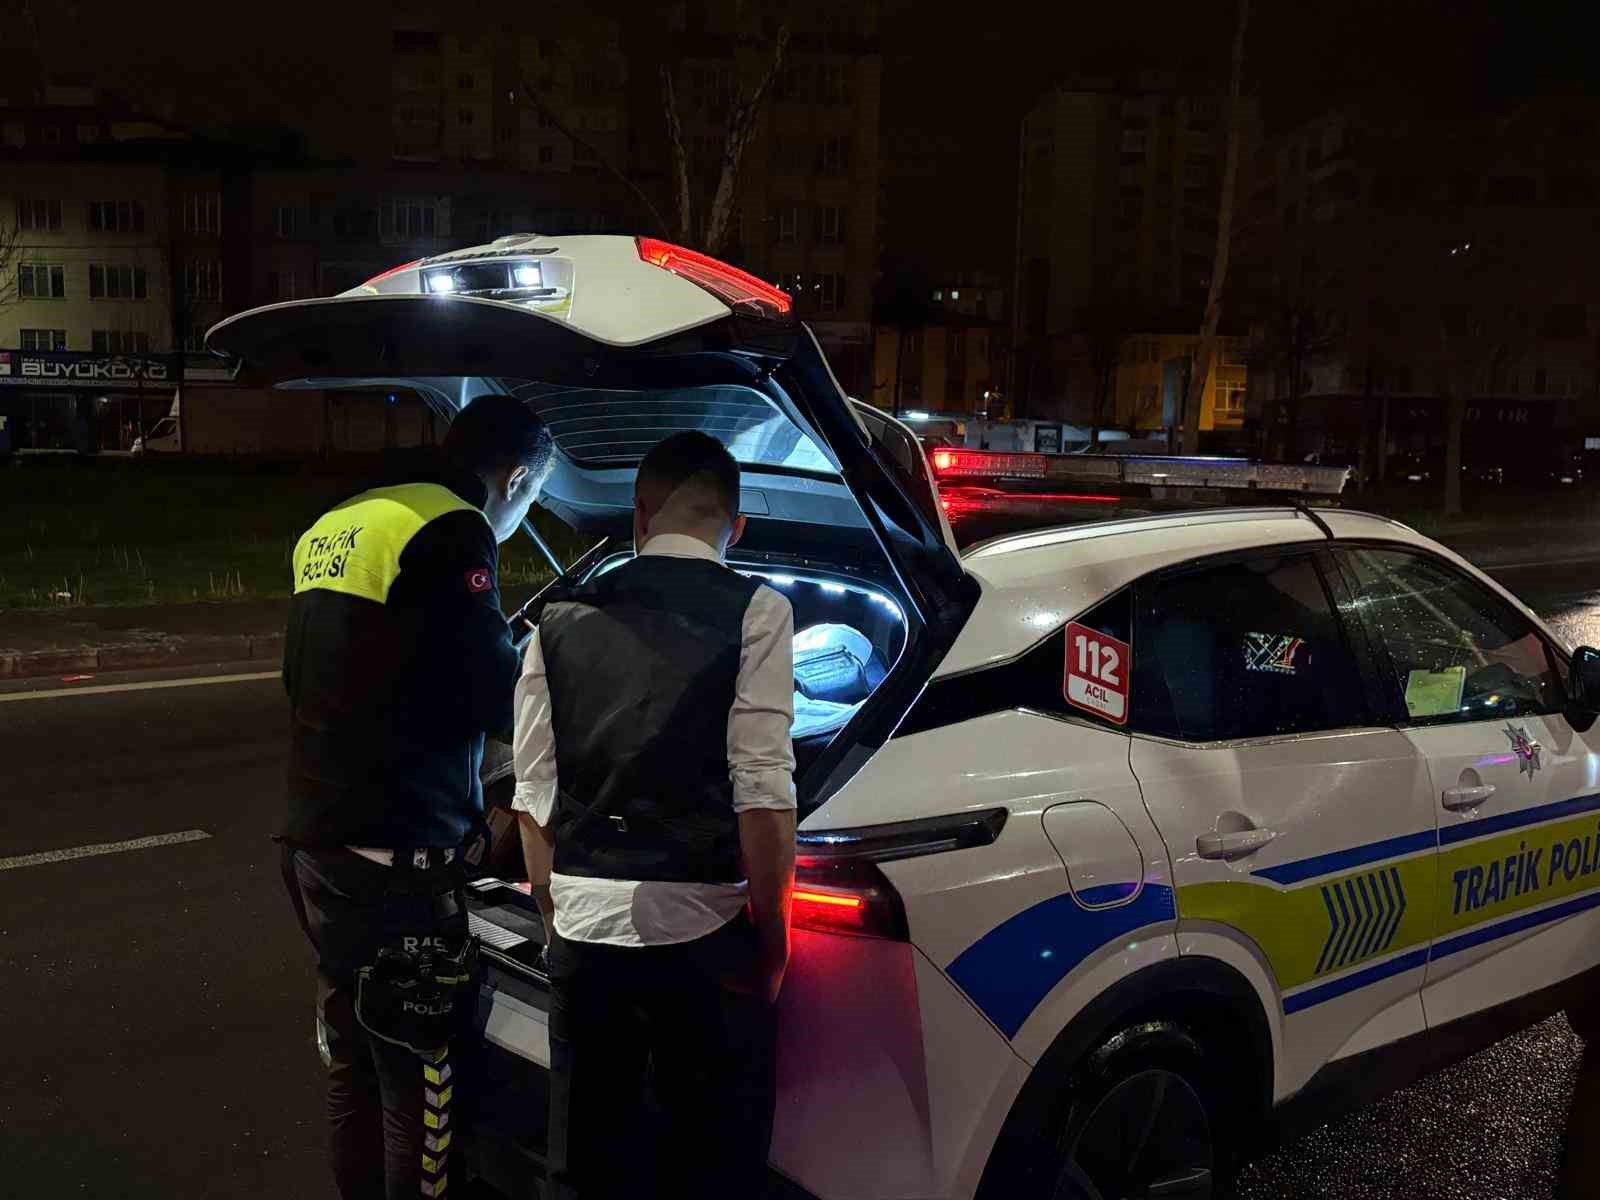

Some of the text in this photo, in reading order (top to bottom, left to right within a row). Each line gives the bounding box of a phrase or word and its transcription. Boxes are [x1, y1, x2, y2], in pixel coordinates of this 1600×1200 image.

[308, 525, 363, 558] TRAFİK
[1075, 635, 1120, 686] 112
[1453, 841, 1543, 914] TRAFİK
